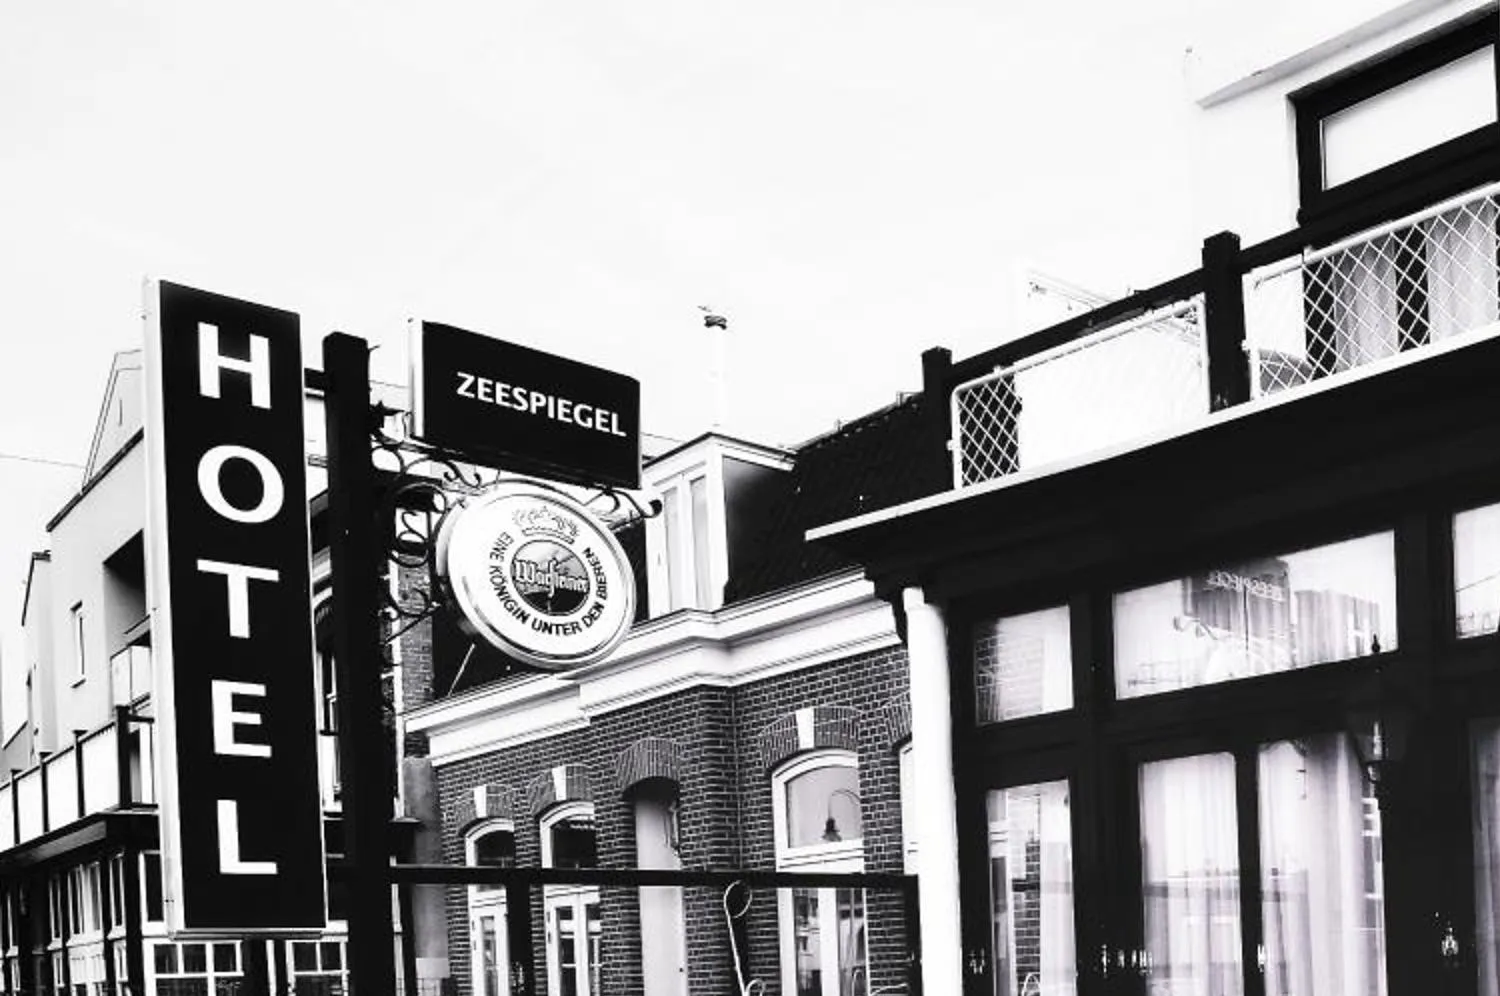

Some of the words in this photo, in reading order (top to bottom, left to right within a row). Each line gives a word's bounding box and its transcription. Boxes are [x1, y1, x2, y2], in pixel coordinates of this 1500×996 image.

[456, 372, 627, 437] ZEESPIEGEL
[490, 531, 515, 564] EINE
[197, 322, 284, 876] HOTEL
[489, 565, 531, 625] KÖNIGIN
[581, 602, 606, 628] DEN
[532, 618, 582, 636] UNTER
